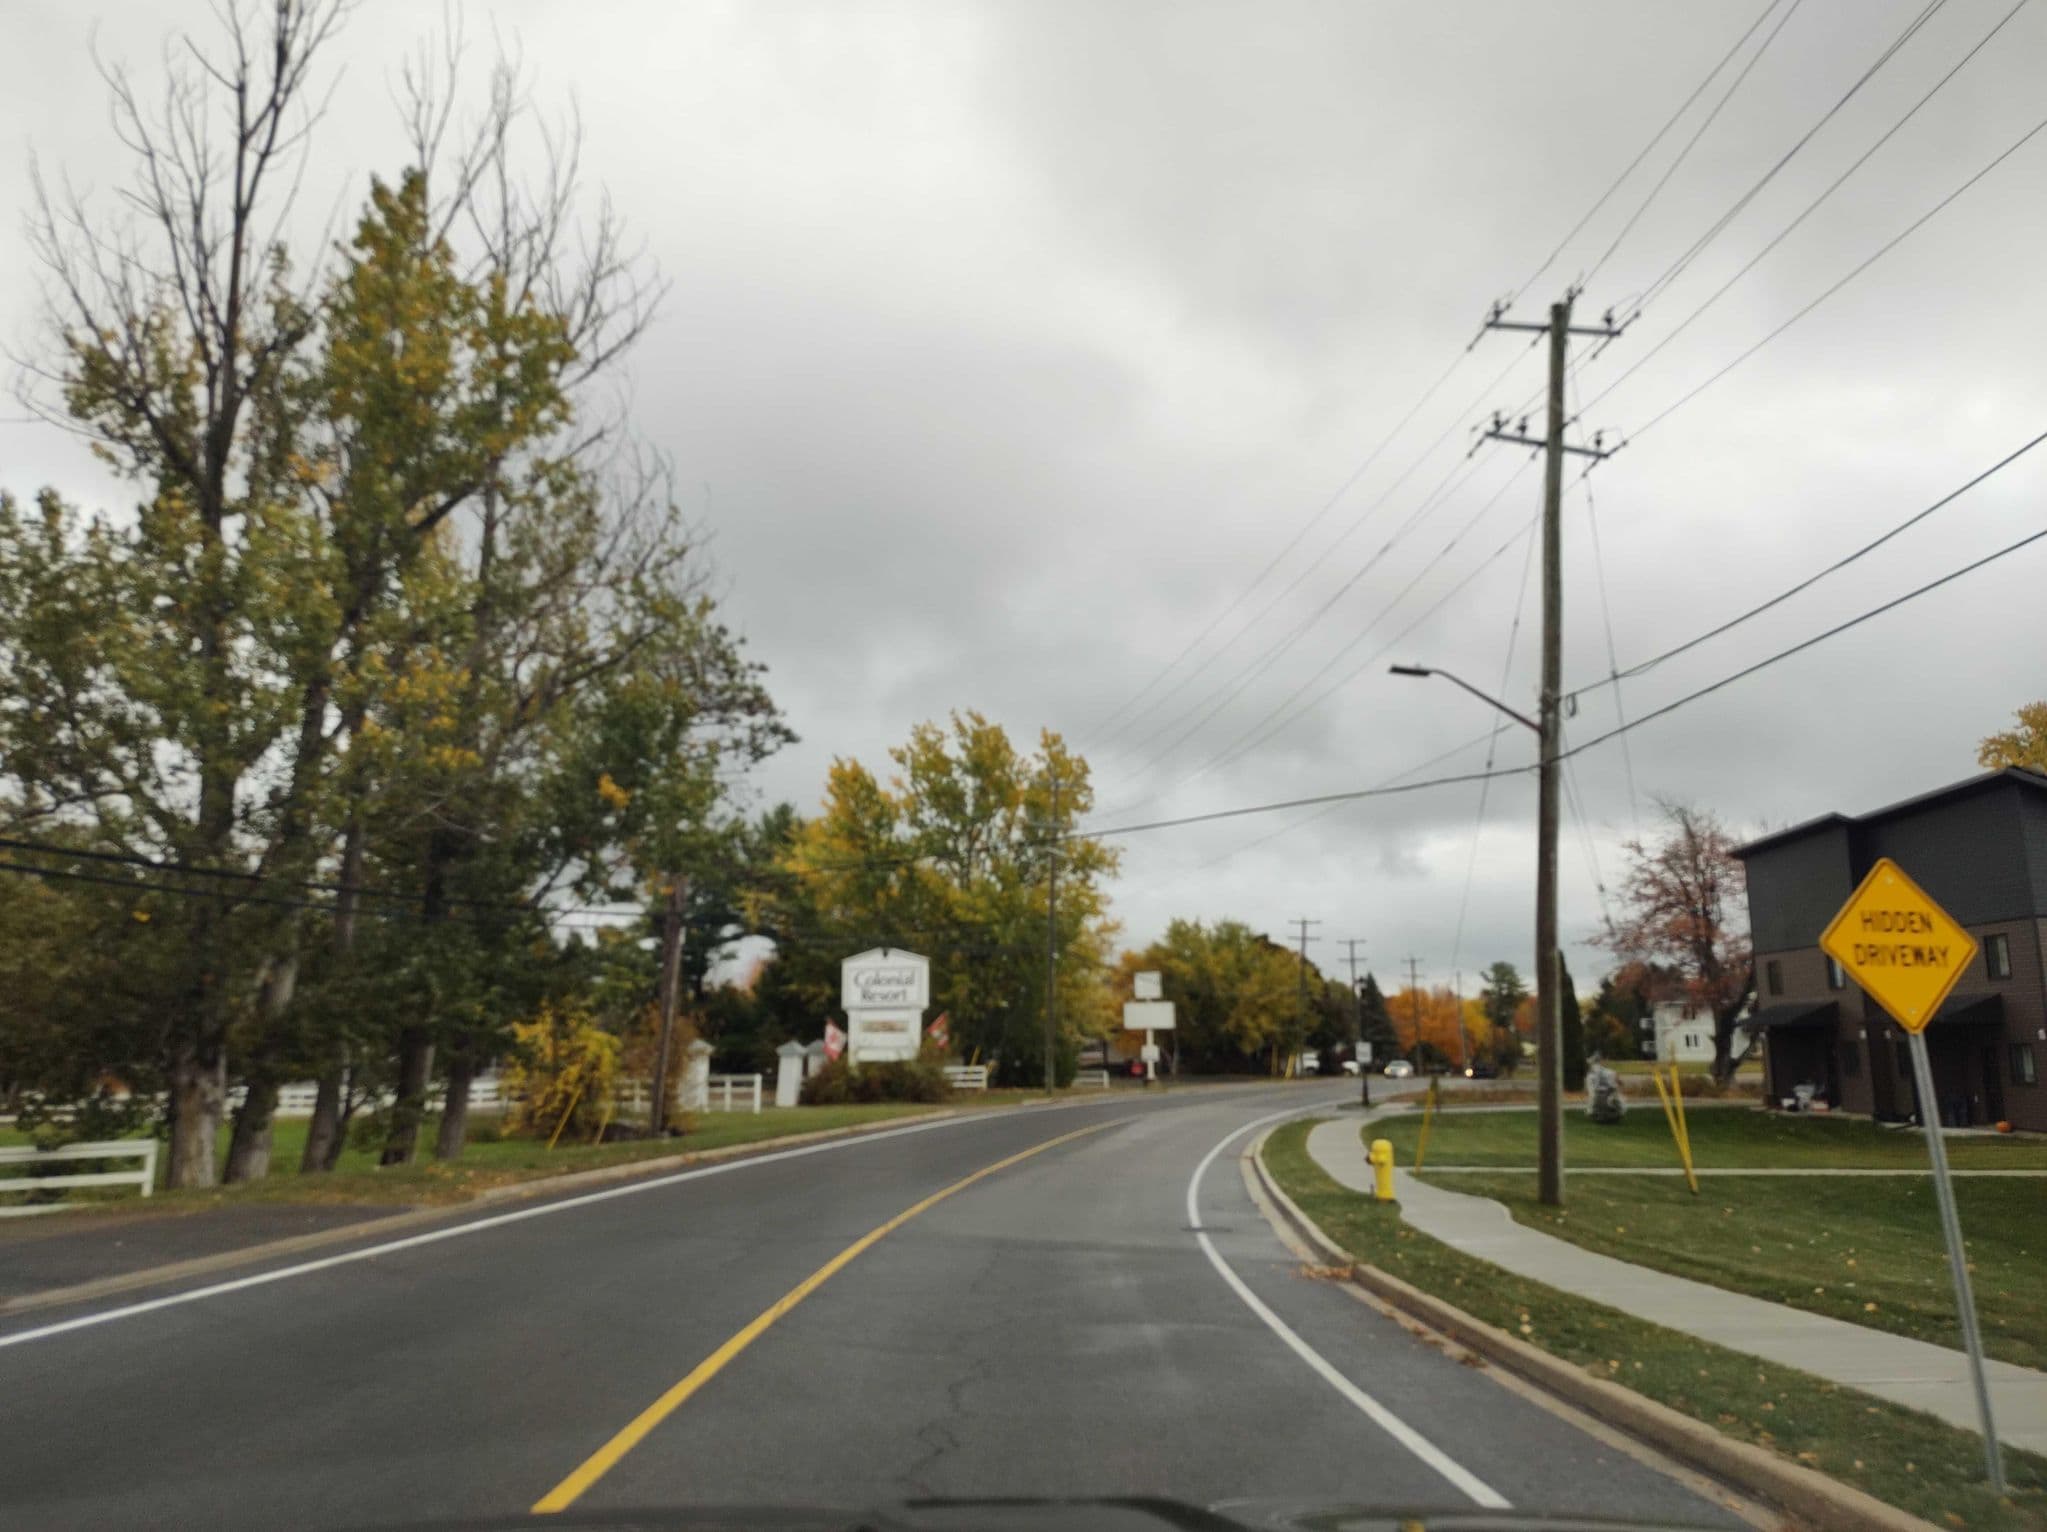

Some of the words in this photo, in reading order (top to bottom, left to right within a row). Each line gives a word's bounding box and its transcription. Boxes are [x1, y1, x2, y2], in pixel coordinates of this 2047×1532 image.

[1860, 910, 1933, 934] HIDDEN
[1853, 943, 1950, 968] DRIVEWAY
[854, 968, 916, 988] Colonial
[861, 987, 908, 1002] Resort
